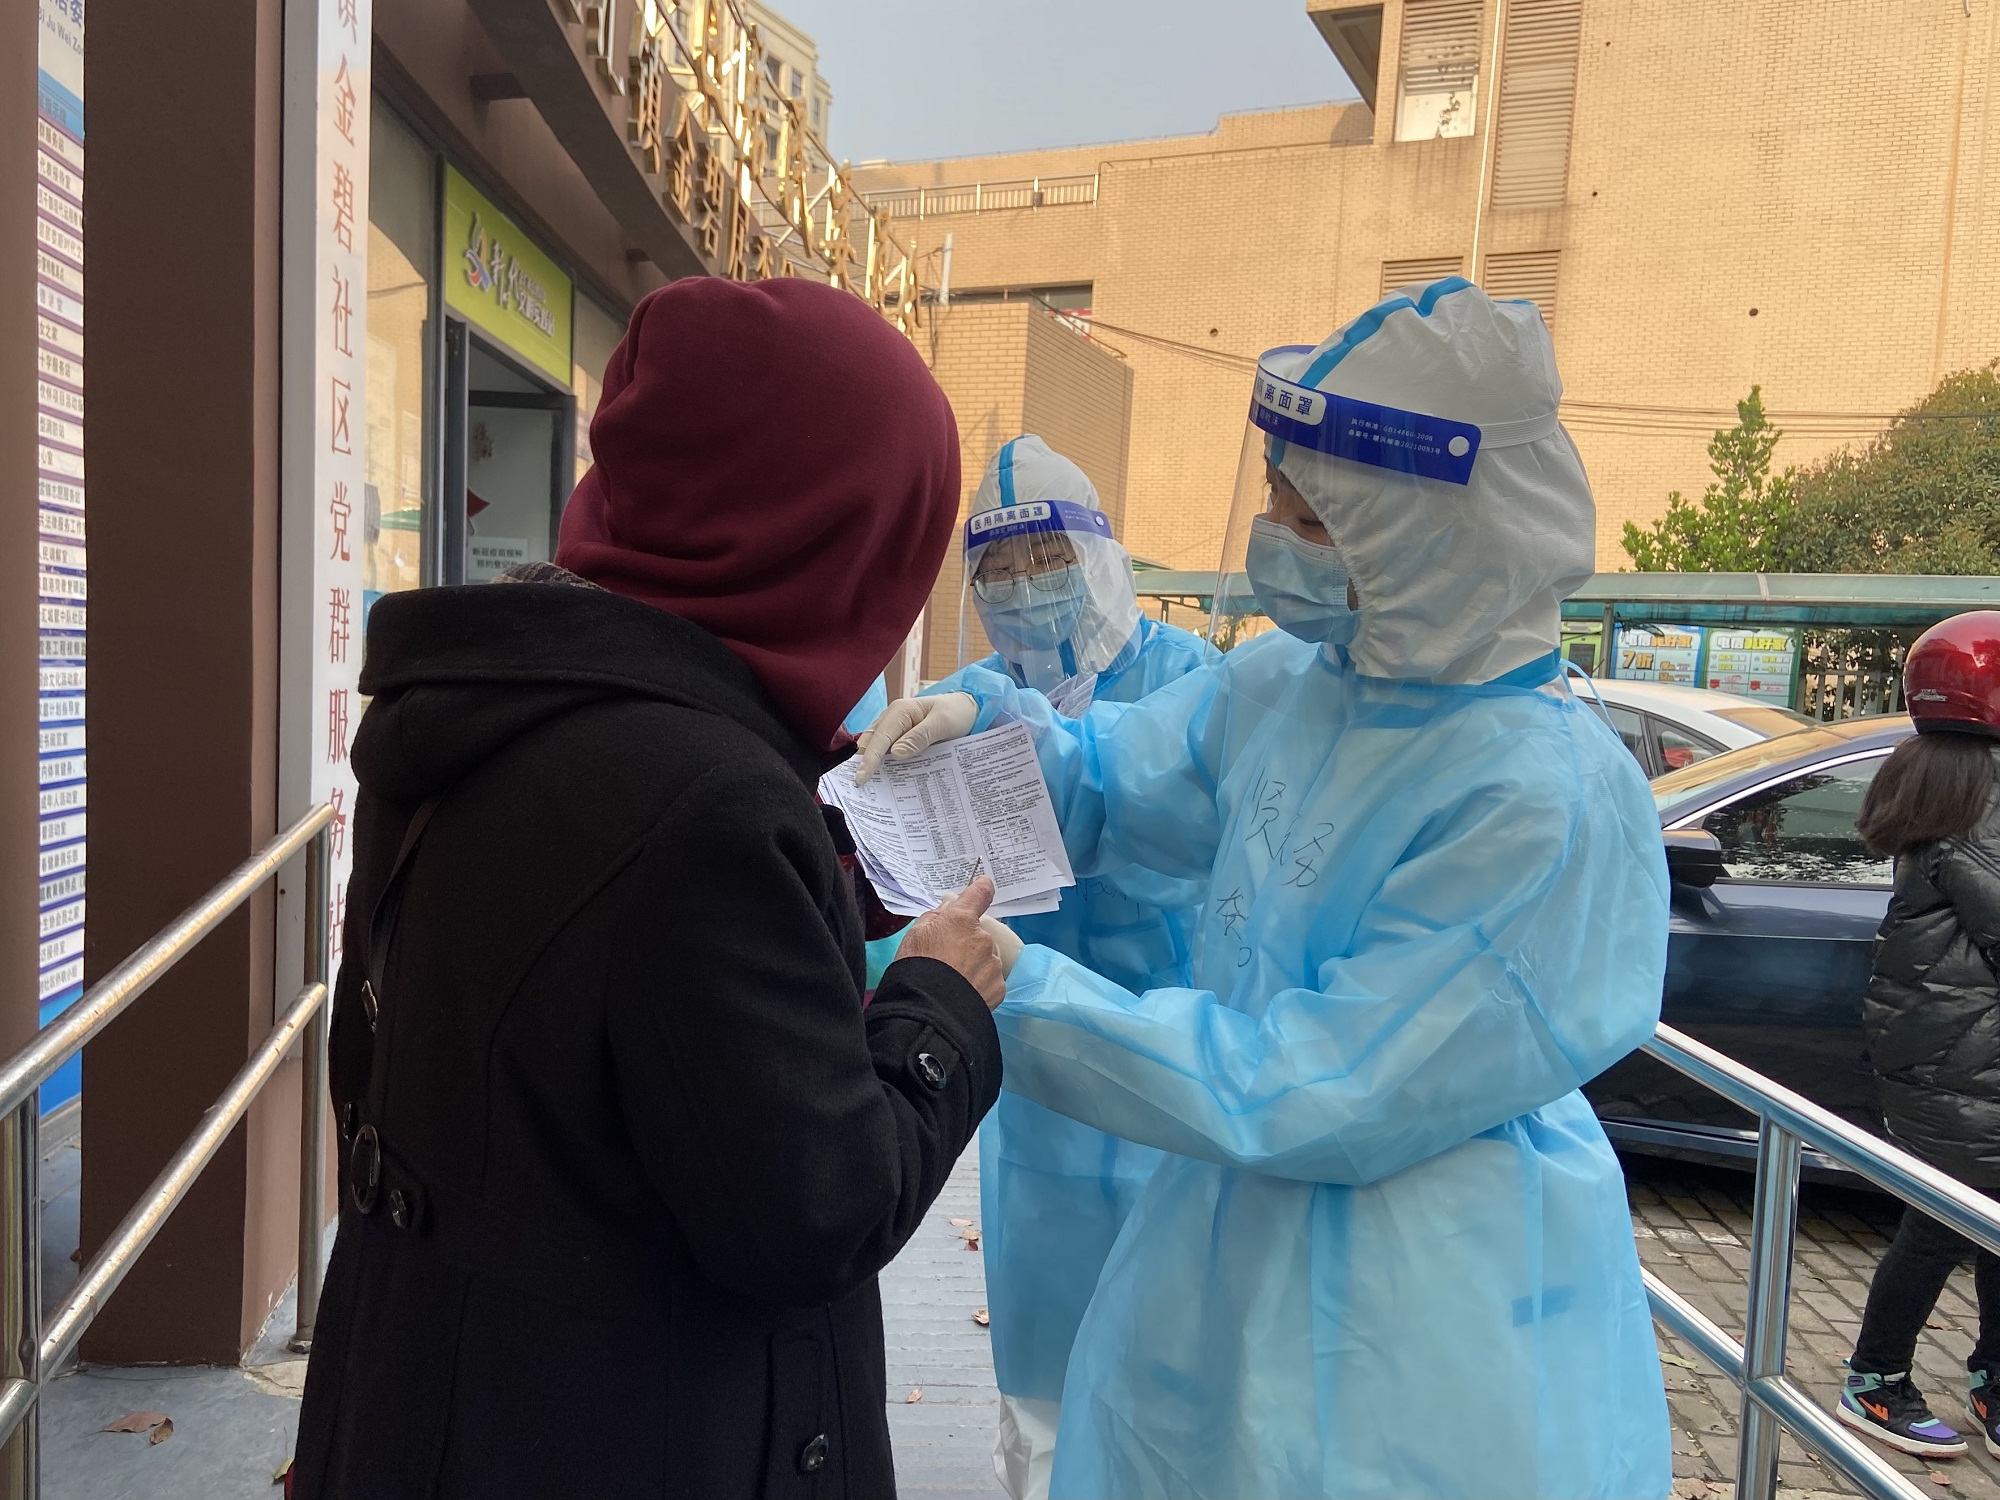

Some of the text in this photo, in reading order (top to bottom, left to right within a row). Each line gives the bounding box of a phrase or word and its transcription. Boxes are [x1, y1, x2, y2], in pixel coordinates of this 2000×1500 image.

[46, 14, 55, 32] Ju
[58, 22, 71, 46] Wei
[40, 321, 58, 341] 女之家
[40, 352, 71, 378] 十字服务站
[39, 513, 85, 534] 共法律服务工作
[974, 506, 1044, 530] 医用隔离面罩
[40, 905, 80, 931] 生协会员之家
